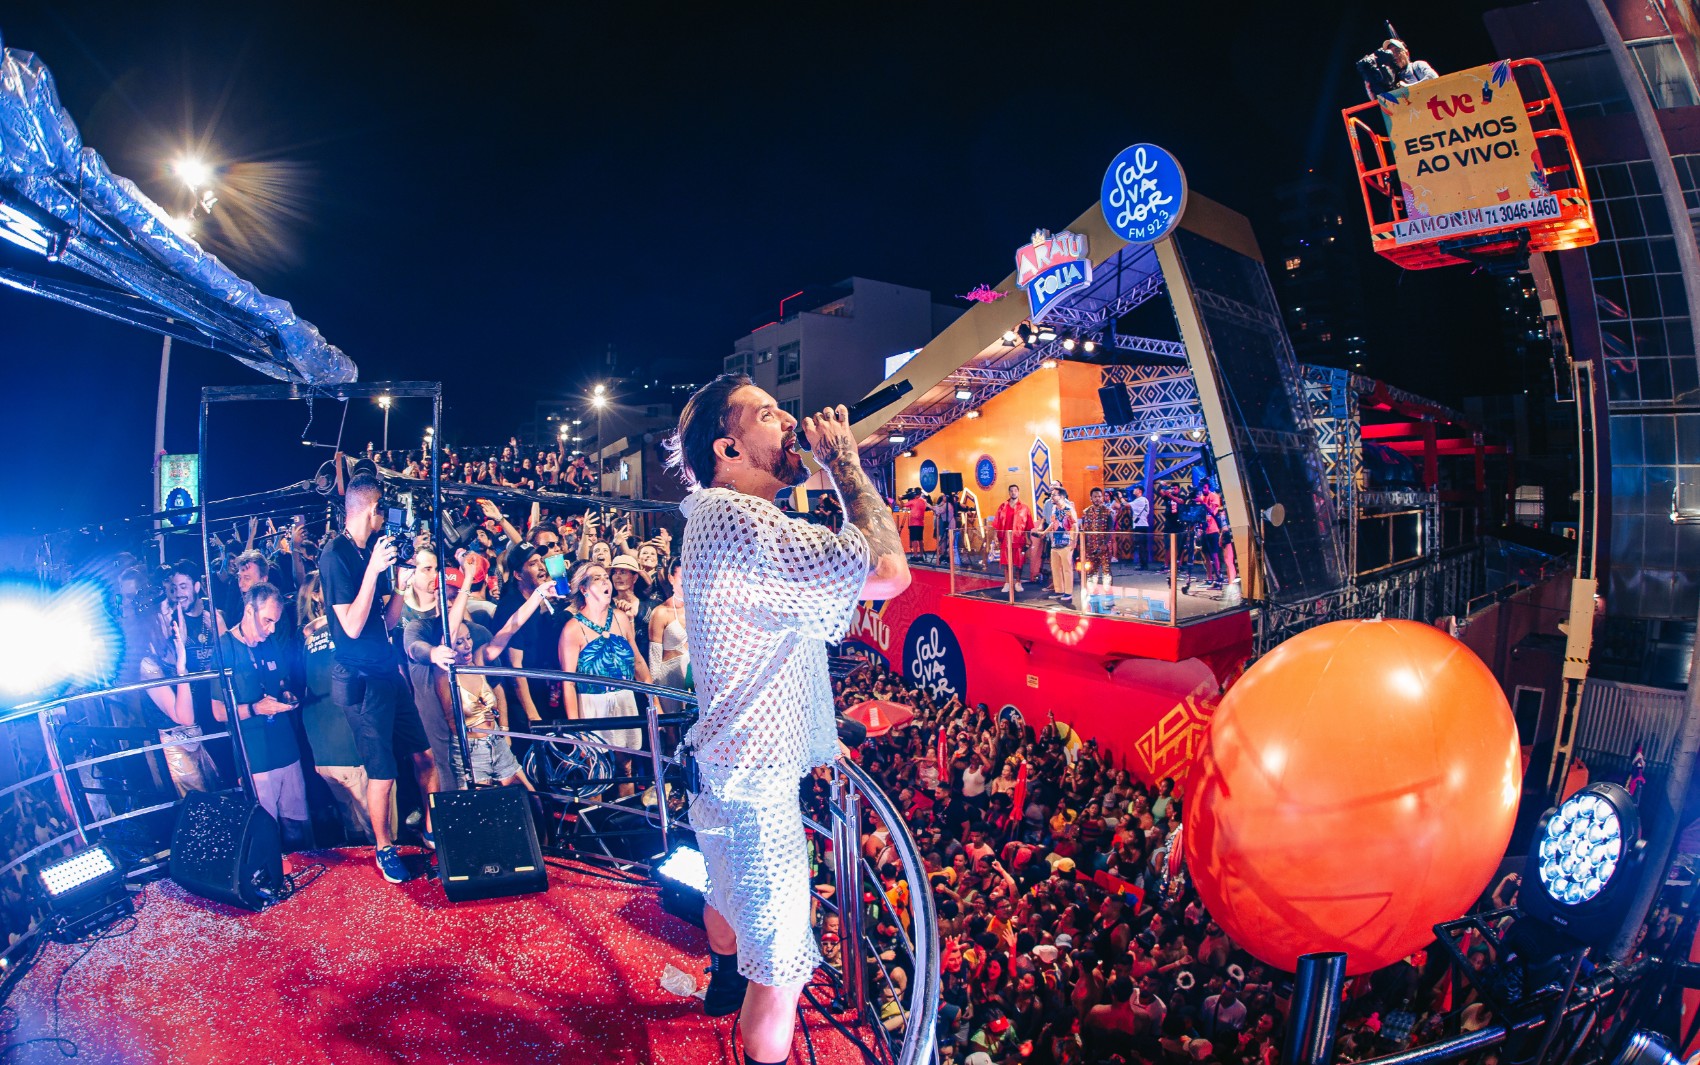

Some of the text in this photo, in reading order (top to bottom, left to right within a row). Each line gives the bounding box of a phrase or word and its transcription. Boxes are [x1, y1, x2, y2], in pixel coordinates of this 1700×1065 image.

[1427, 94, 1475, 120] tve
[1404, 116, 1517, 156] ESTAMOS
[1417, 139, 1520, 176] AO VIVO!
[1128, 209, 1169, 238] FM 92.3
[1485, 210, 1498, 225] 71
[1500, 197, 1558, 223] 3046-1460
[1018, 232, 1082, 286] ARATU
[1034, 263, 1083, 304] FOLIA
